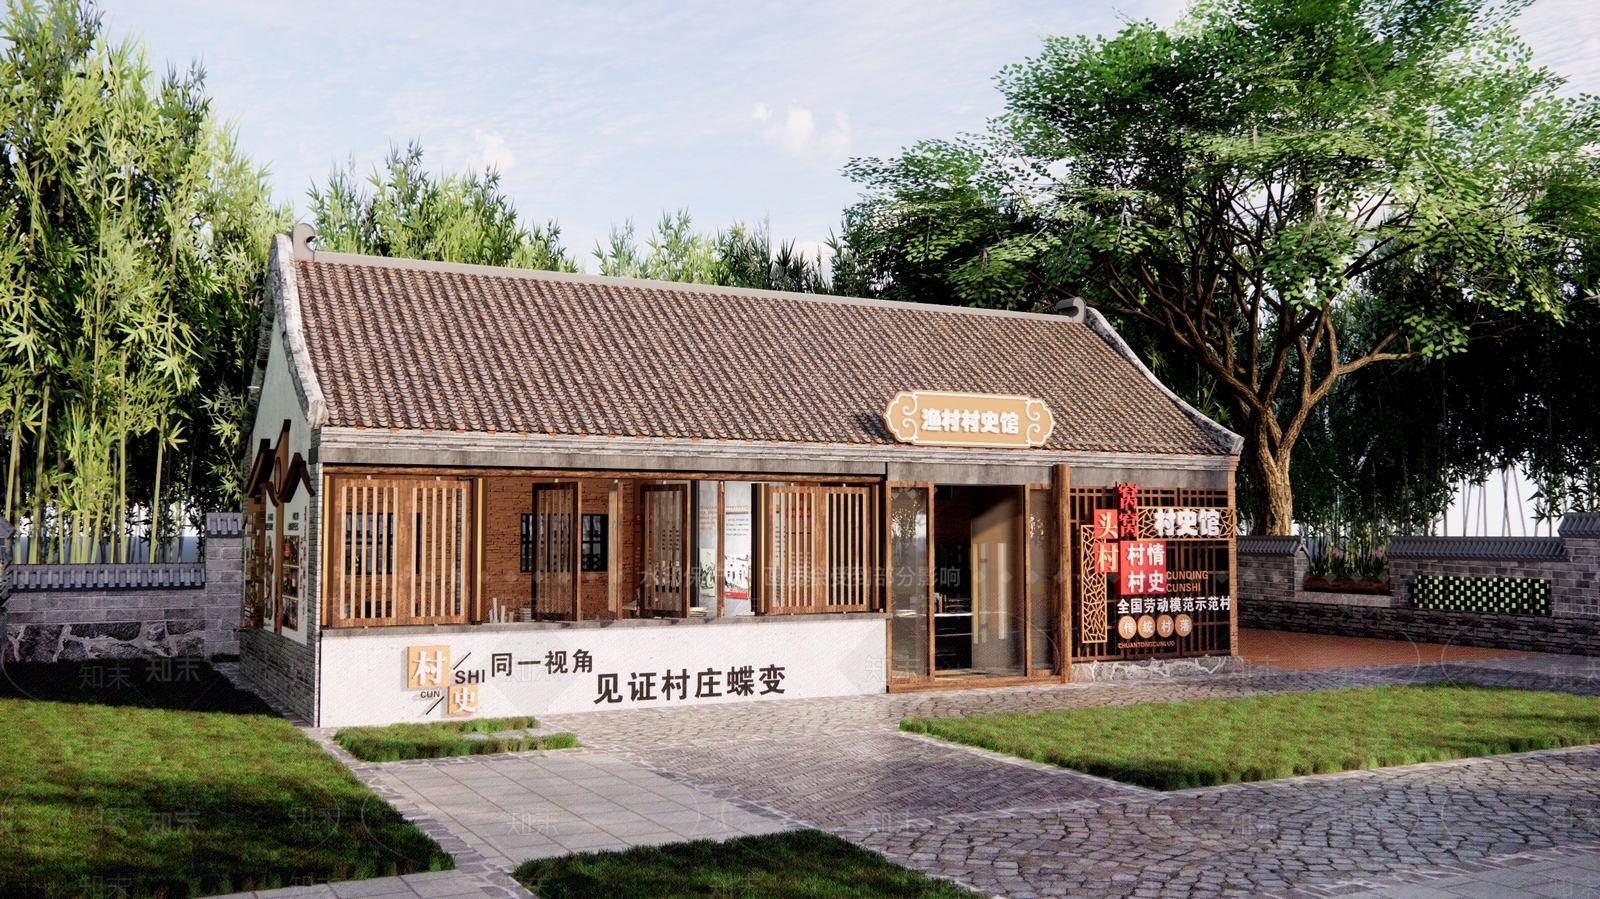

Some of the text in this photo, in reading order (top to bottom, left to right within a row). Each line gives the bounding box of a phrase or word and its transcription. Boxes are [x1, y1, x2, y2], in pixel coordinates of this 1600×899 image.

[921, 408, 1019, 434] 渔村村史馆
[1154, 508, 1220, 537] 村史馆
[1096, 511, 1119, 572] 头村
[1127, 543, 1165, 566] 村情
[1127, 570, 1165, 593] 村史
[1166, 571, 1209, 580] CUNQING
[1166, 583, 1201, 592] CUNSHI
[1117, 596, 1232, 614] 全国劳动模范示范村
[1123, 619, 1191, 635] 传统村落
[413, 651, 447, 685] 村
[491, 649, 593, 677] 同一视角
[455, 670, 485, 684] SHI
[594, 664, 786, 704] 见证村庄蝶变
[420, 691, 441, 699] CUN
[454, 687, 477, 713] 史
